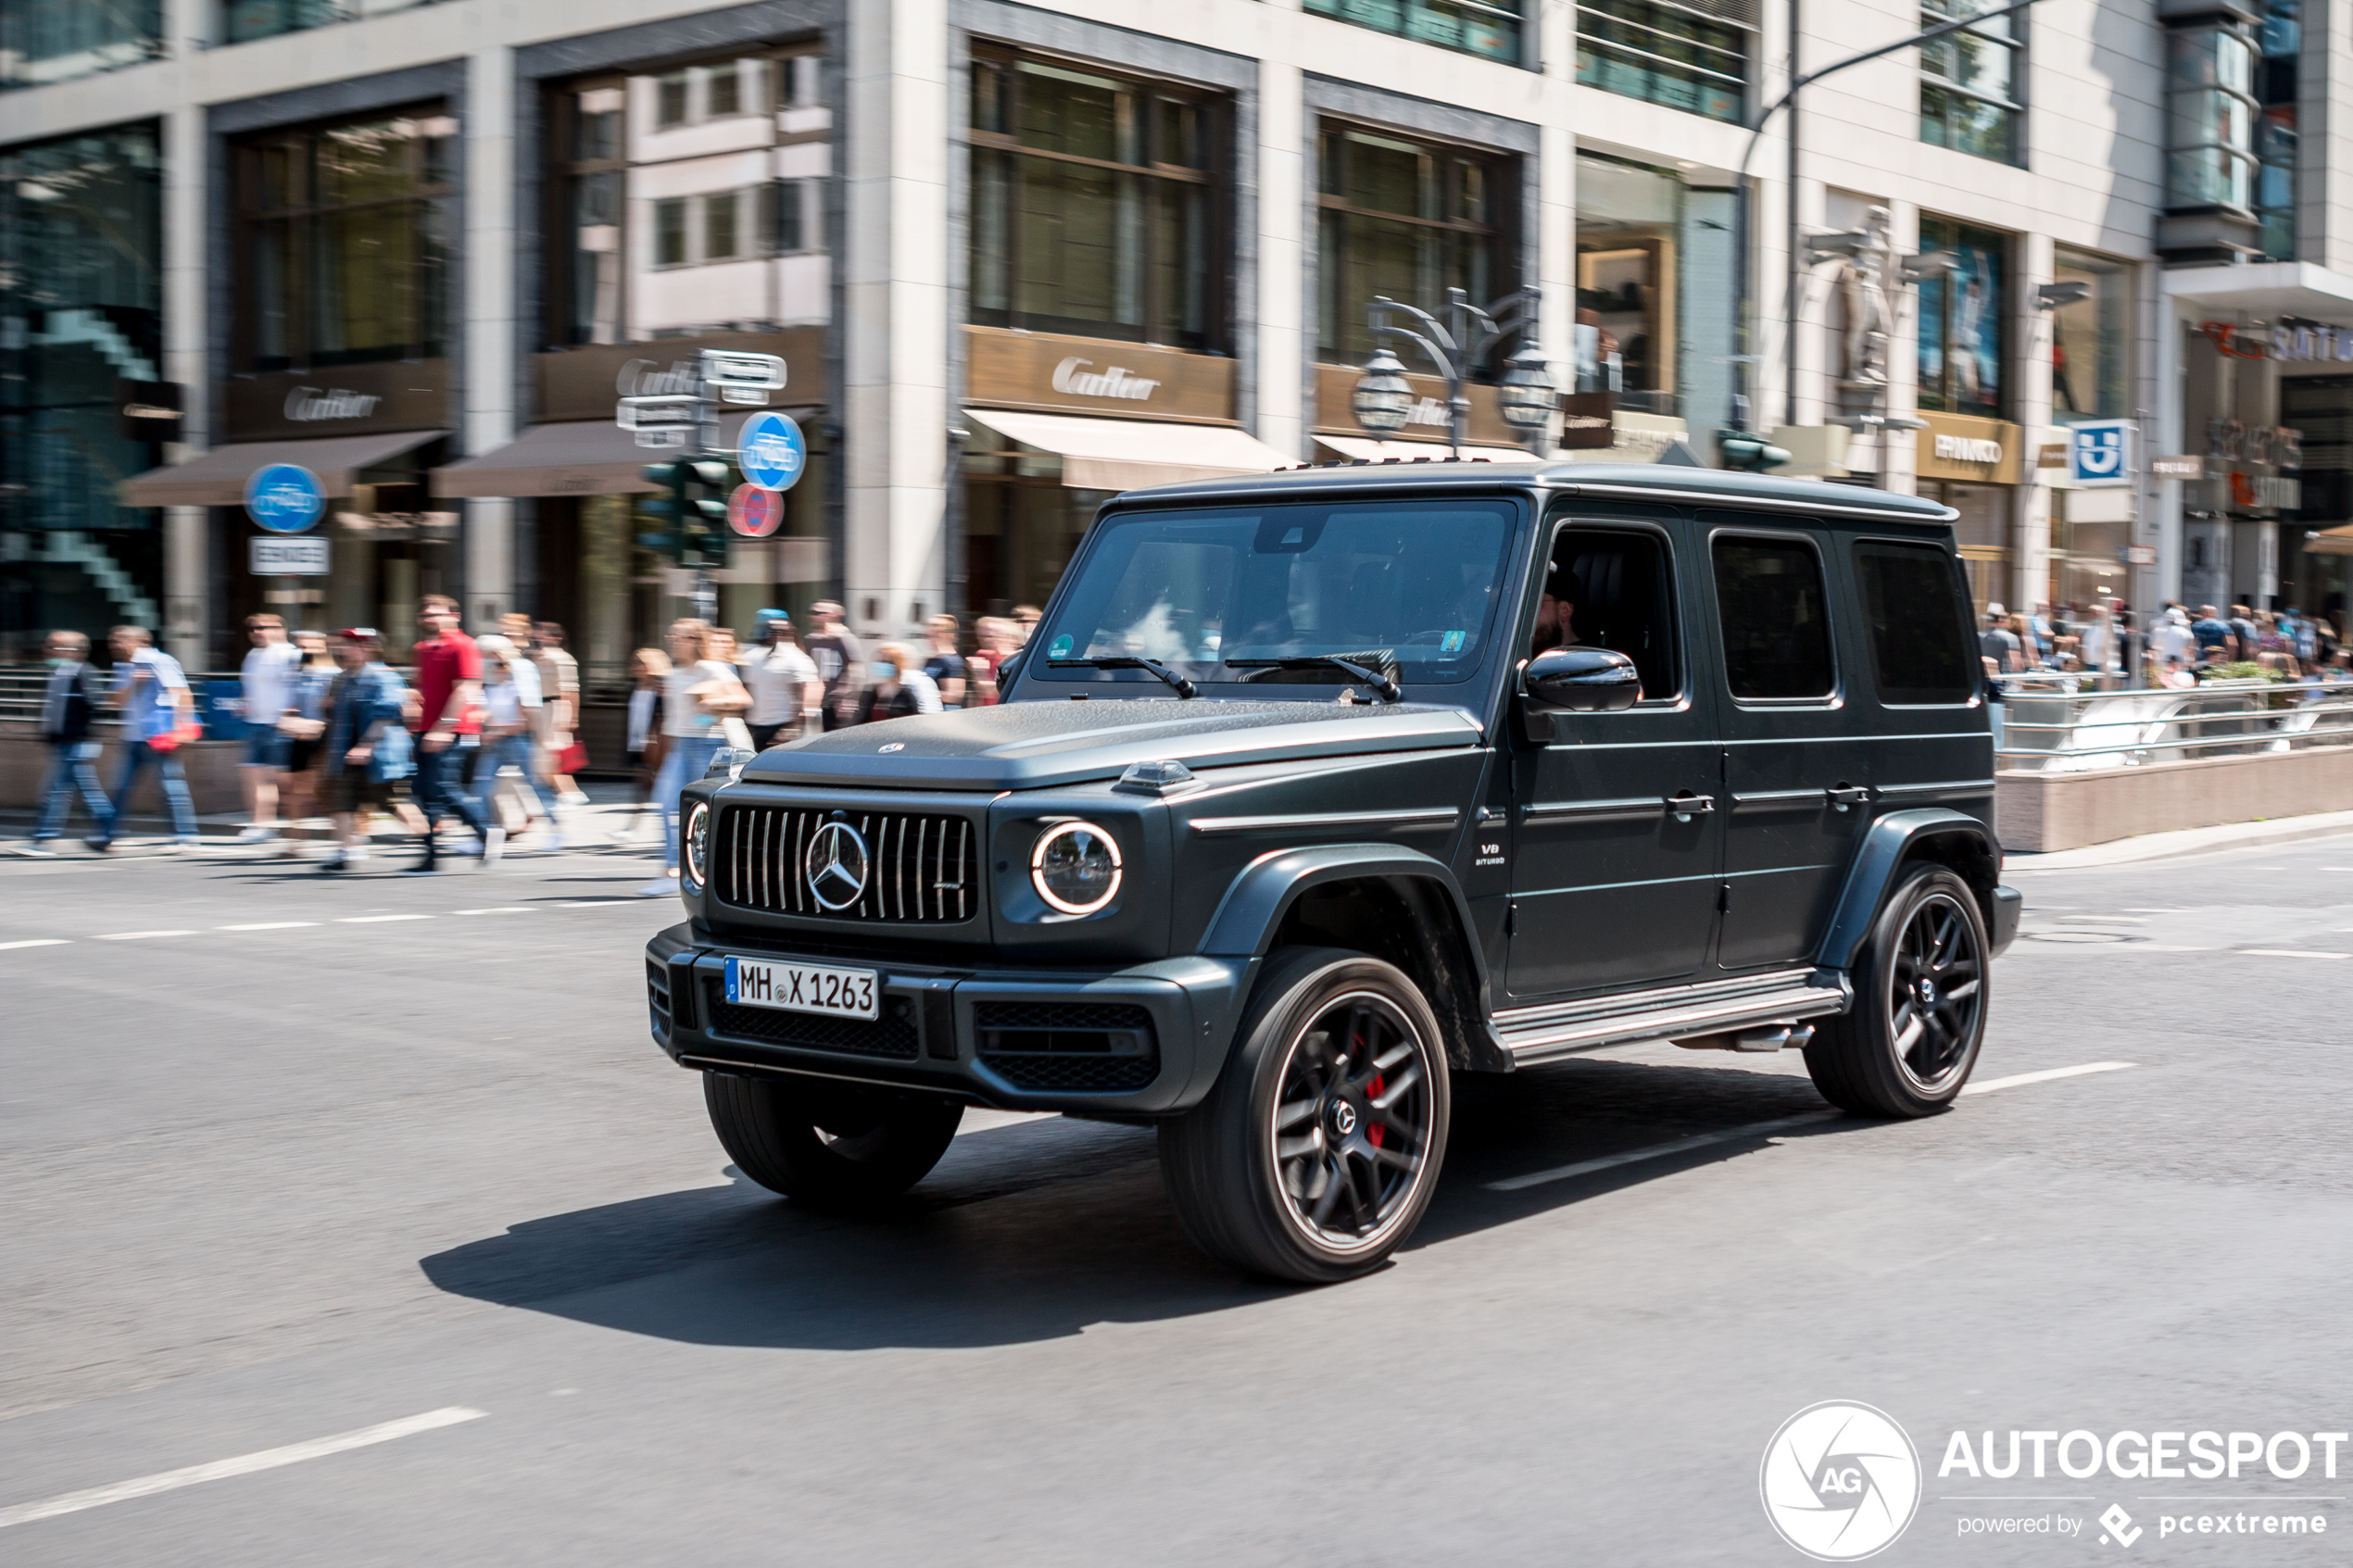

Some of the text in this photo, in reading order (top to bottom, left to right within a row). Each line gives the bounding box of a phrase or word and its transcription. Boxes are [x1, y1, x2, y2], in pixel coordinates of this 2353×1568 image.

[1481, 844, 1500, 854] V8
[1476, 857, 1504, 866] BITURBO
[740, 965, 874, 1011] MH X 1263
